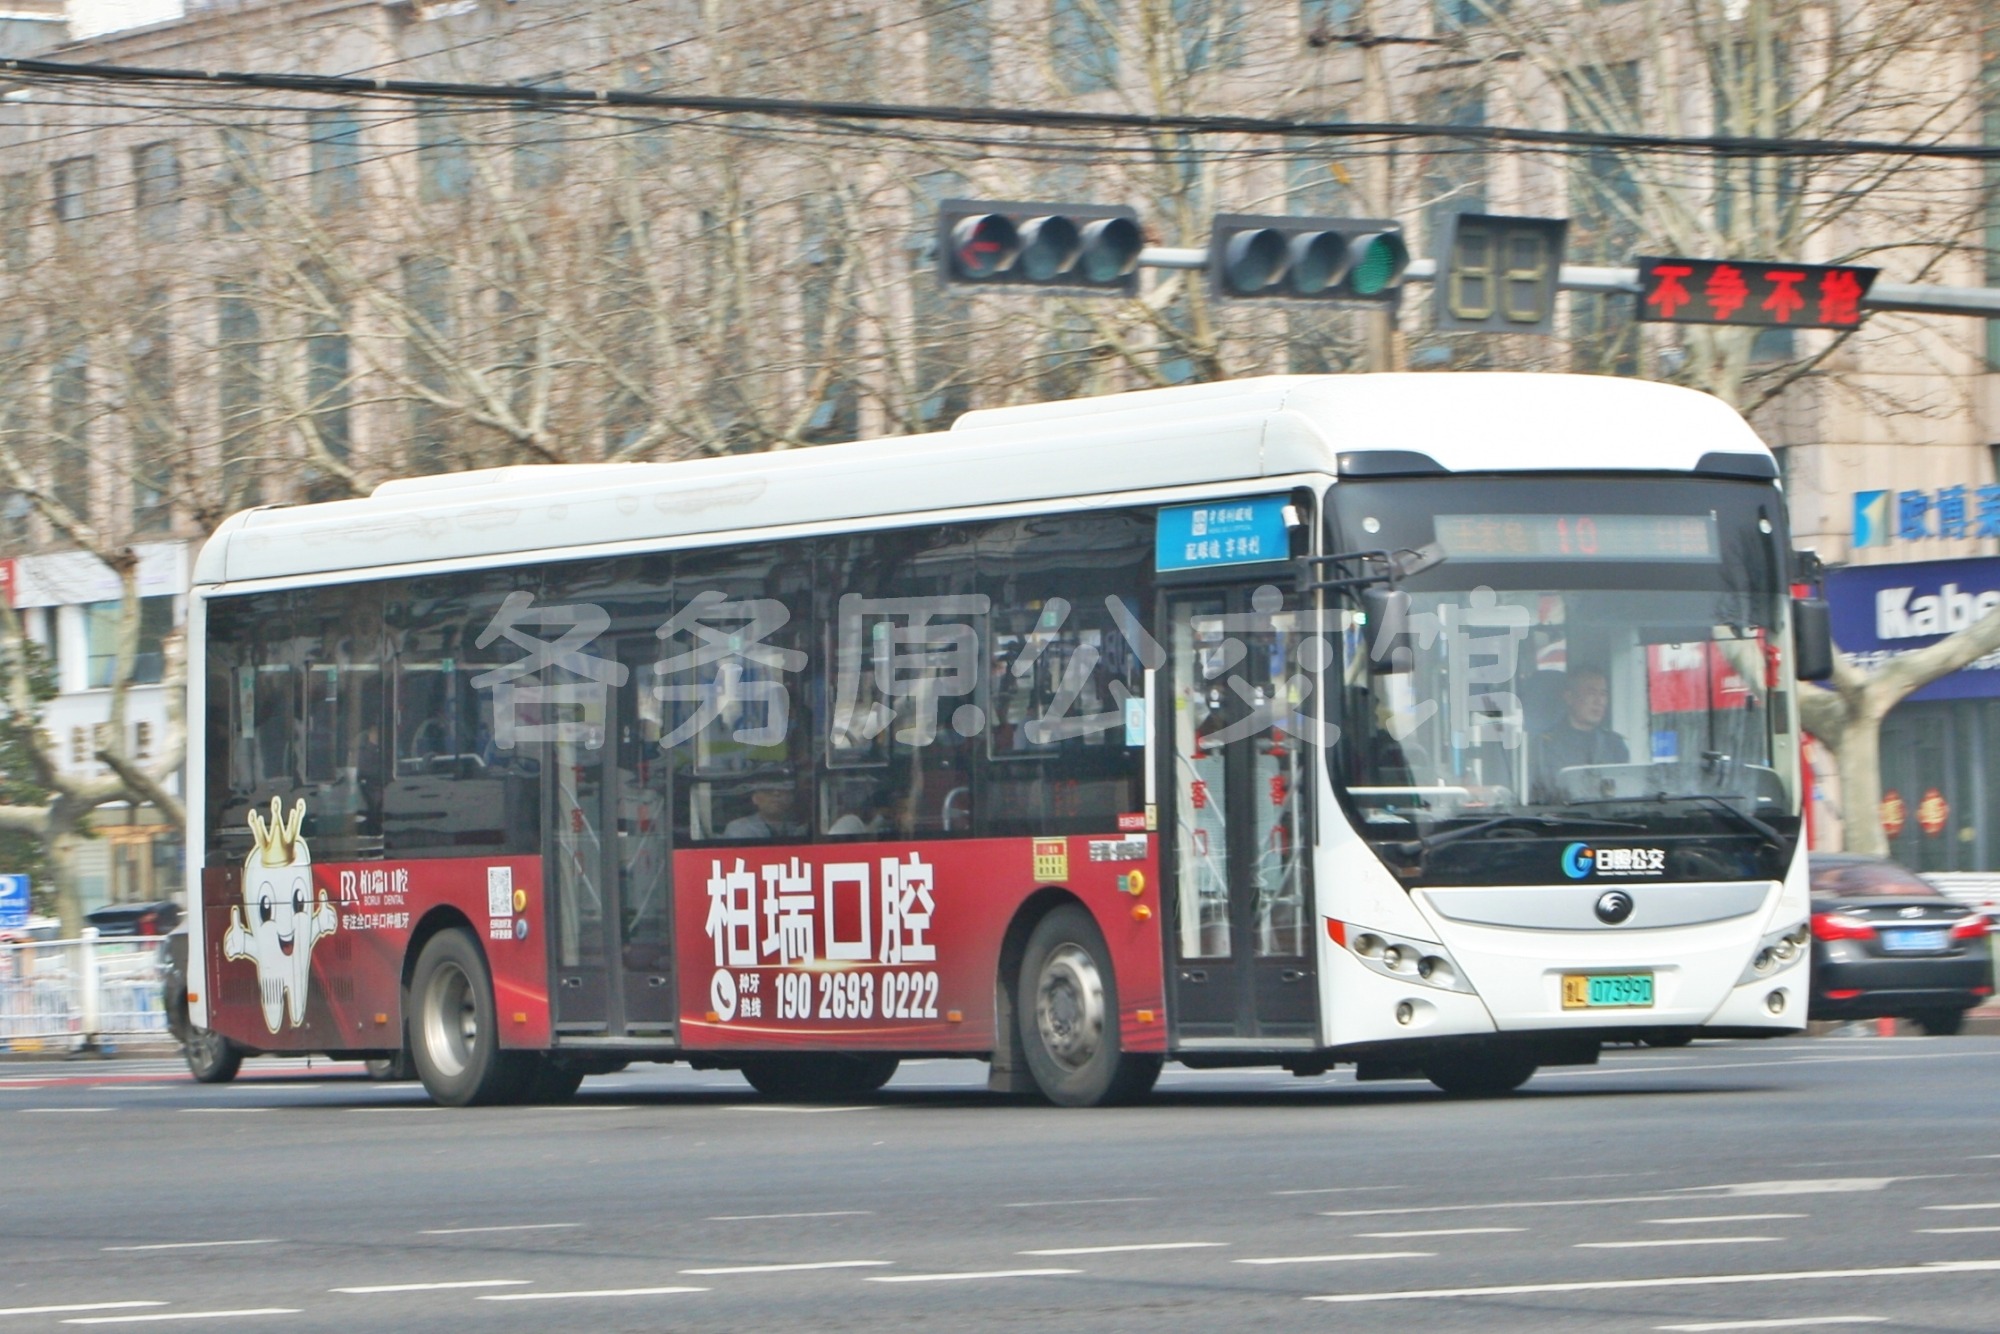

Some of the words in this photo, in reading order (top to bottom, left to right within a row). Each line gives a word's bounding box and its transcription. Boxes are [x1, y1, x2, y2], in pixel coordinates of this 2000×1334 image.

[1647, 264, 1863, 324] 不争不抢
[1556, 516, 1599, 555] 10
[1596, 848, 1666, 870] 日照公交
[360, 867, 408, 895] 柏瑞口腔
[705, 851, 937, 967] 柏瑞口腔
[739, 973, 760, 994] 种牙
[775, 972, 812, 1019] 190
[818, 972, 874, 1019] 2693
[881, 971, 939, 1019] 0222
[740, 997, 762, 1018] 热线
